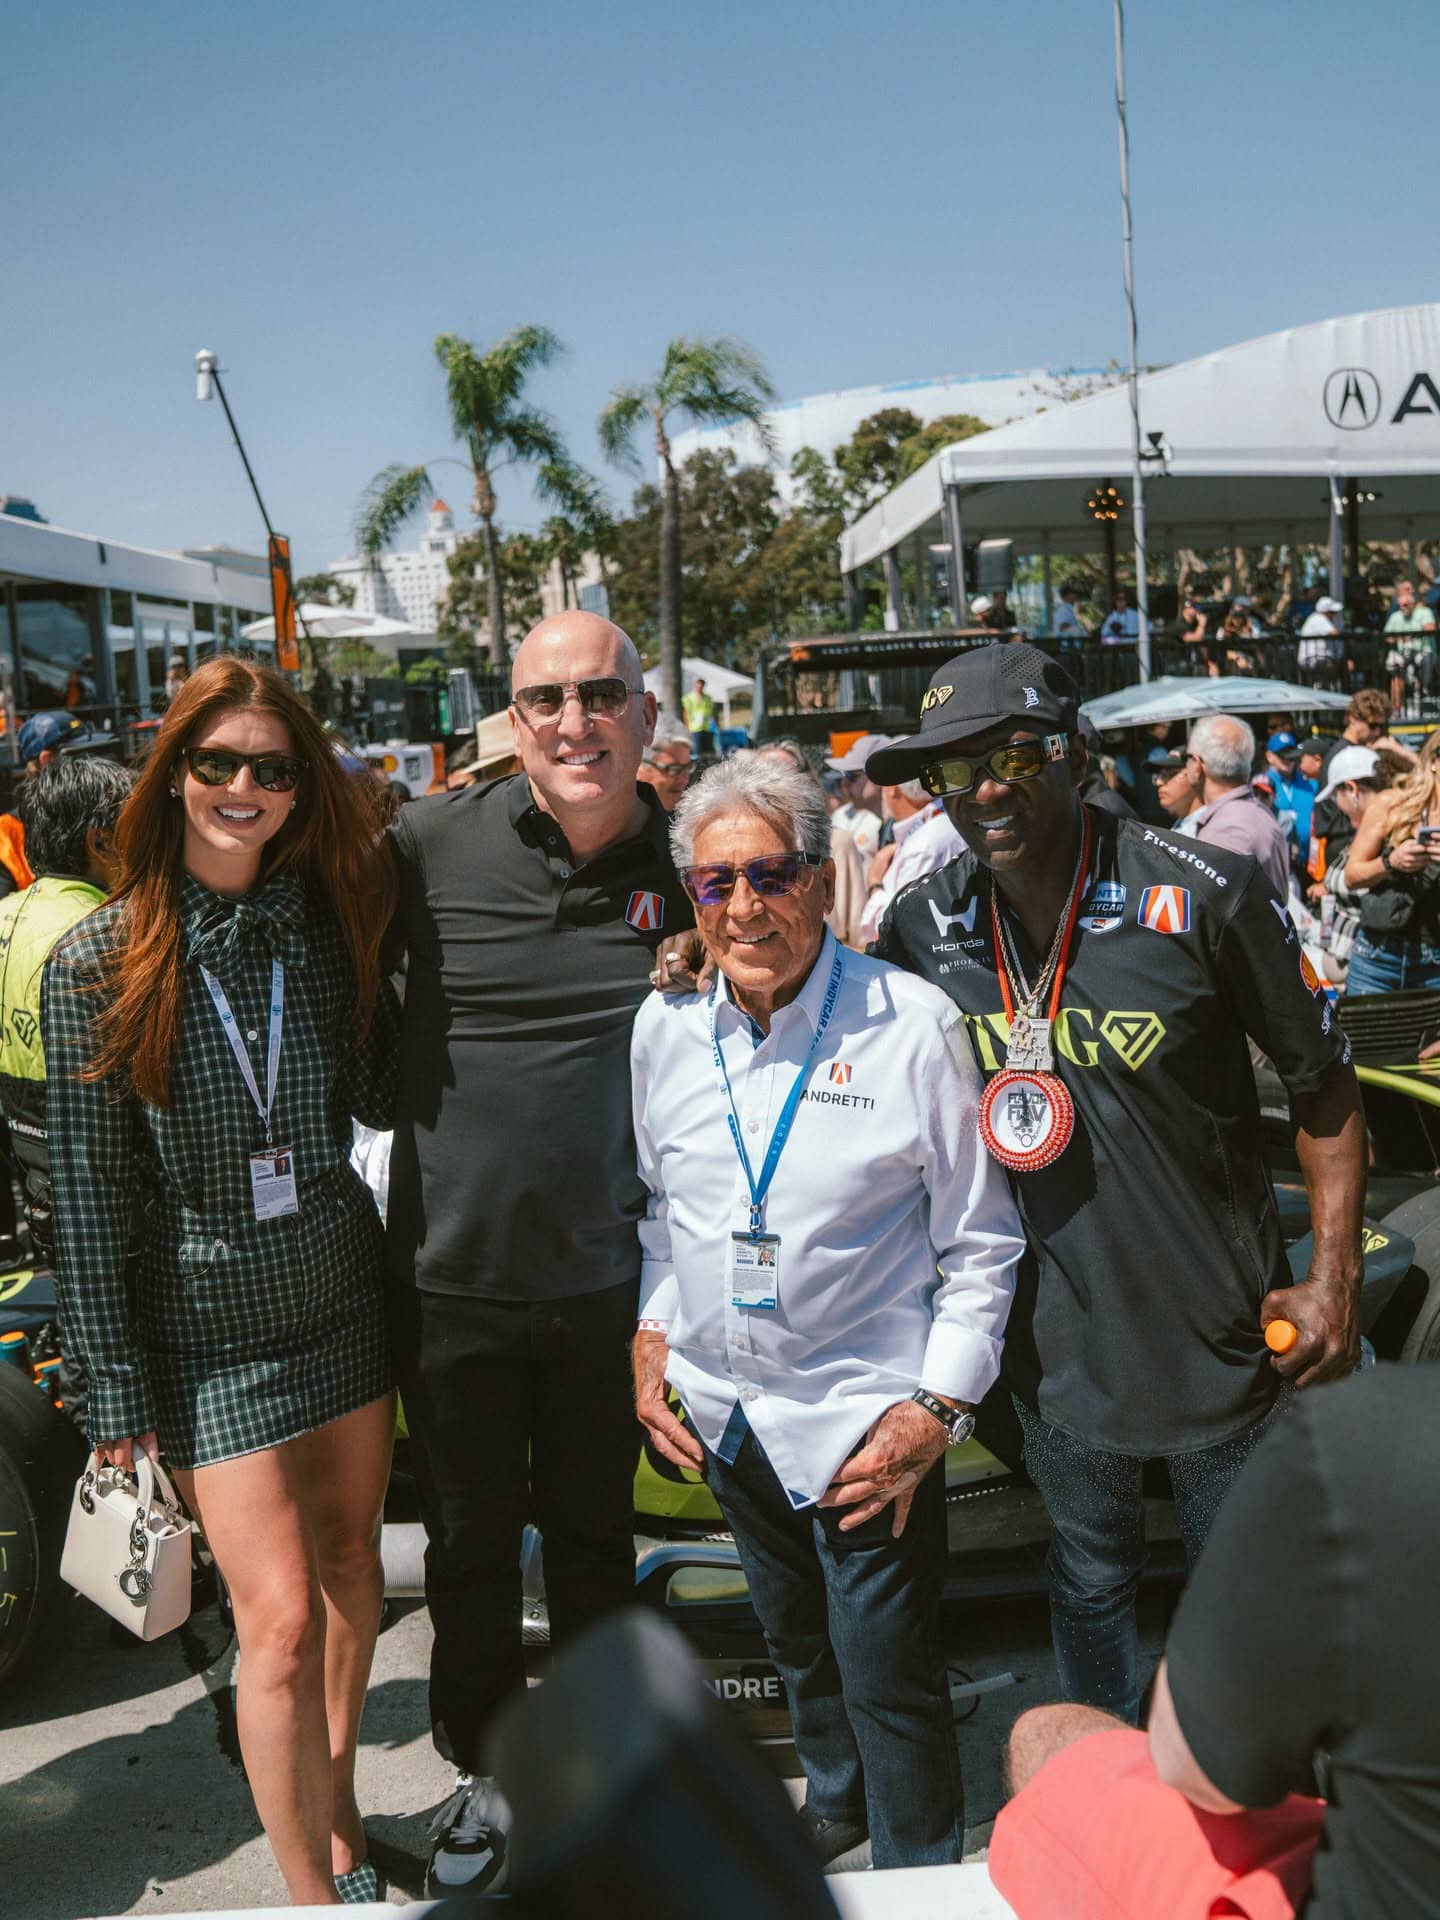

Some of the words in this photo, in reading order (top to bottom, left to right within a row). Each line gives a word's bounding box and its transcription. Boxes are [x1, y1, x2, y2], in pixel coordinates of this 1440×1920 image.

[1144, 829, 1228, 887] Firestone
[1096, 889, 1121, 899] NTT
[932, 938, 985, 953] Honda
[819, 982, 840, 1029] INDYCAR
[800, 1089, 875, 1110] ANDRETTI
